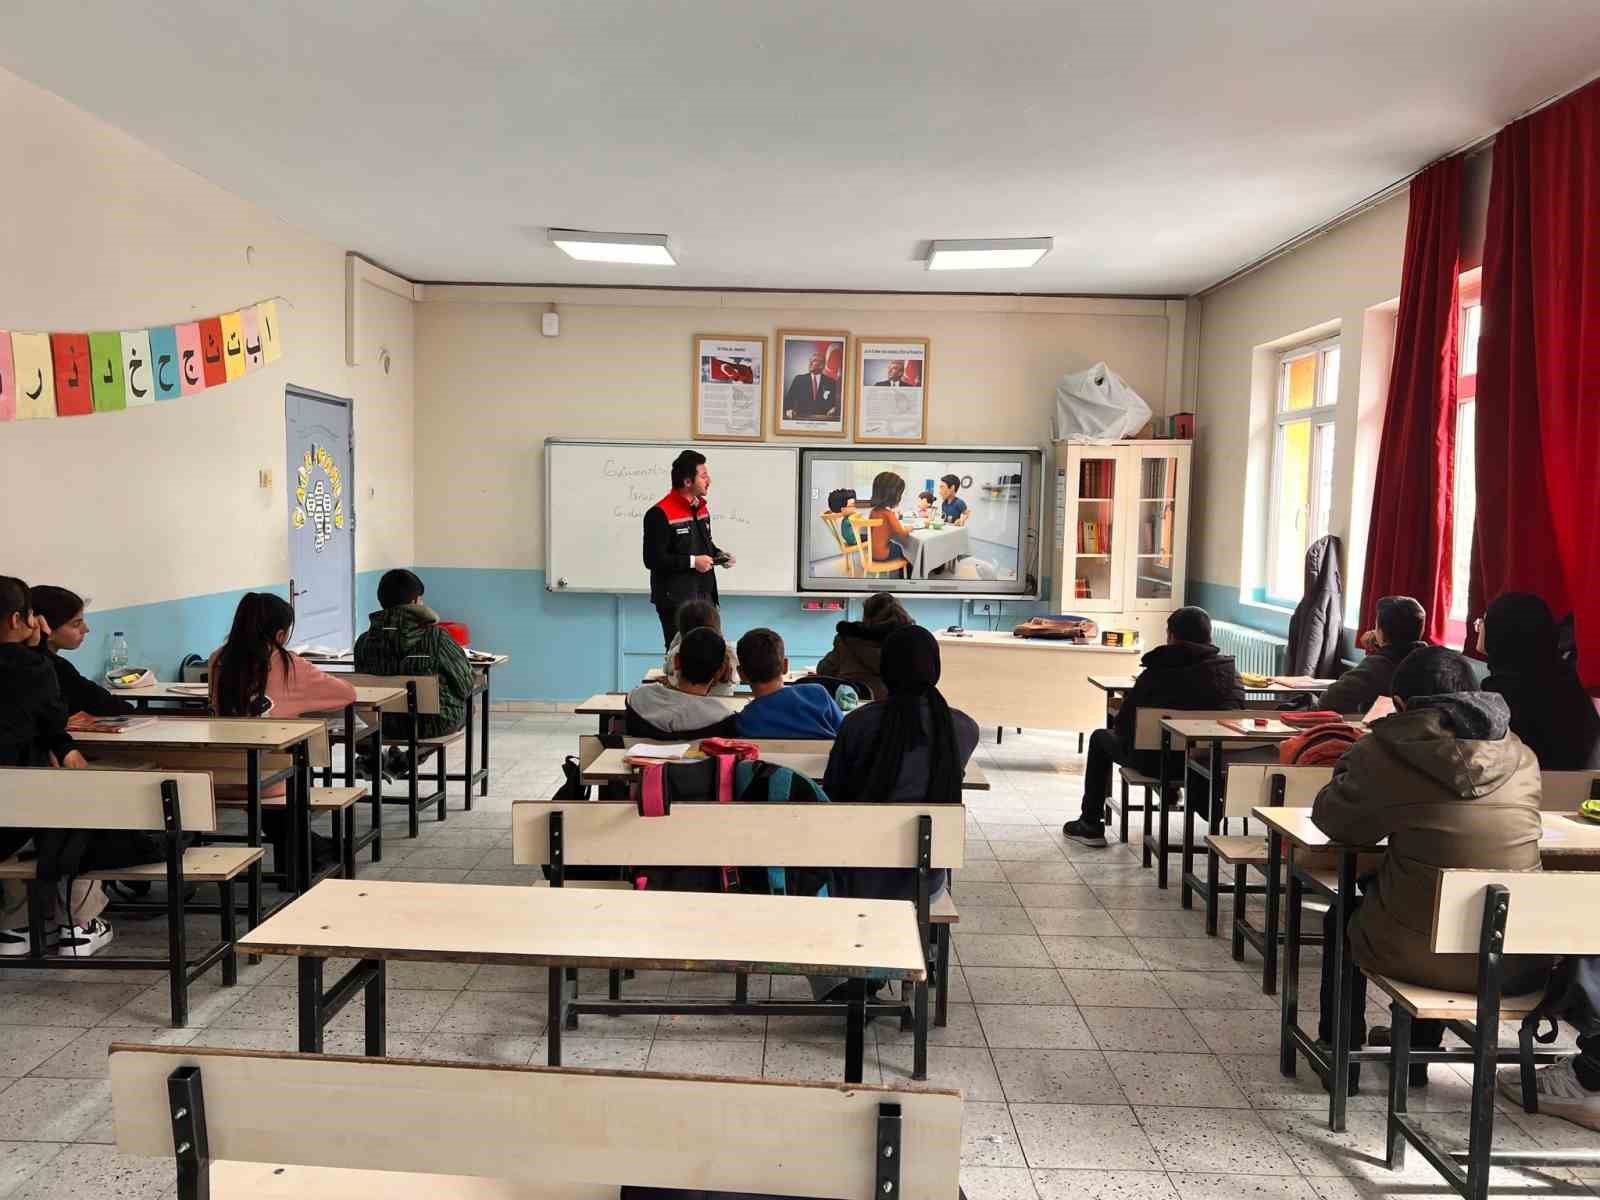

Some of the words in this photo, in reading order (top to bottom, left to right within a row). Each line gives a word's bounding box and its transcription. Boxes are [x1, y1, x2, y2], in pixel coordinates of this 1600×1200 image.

[205, 333, 220, 363] ث
[227, 332, 241, 356] ت
[246, 335, 261, 364] ب
[129, 347, 148, 398] خ
[158, 354, 175, 392] ح
[182, 350, 199, 385] ج
[25, 368, 43, 400] ر
